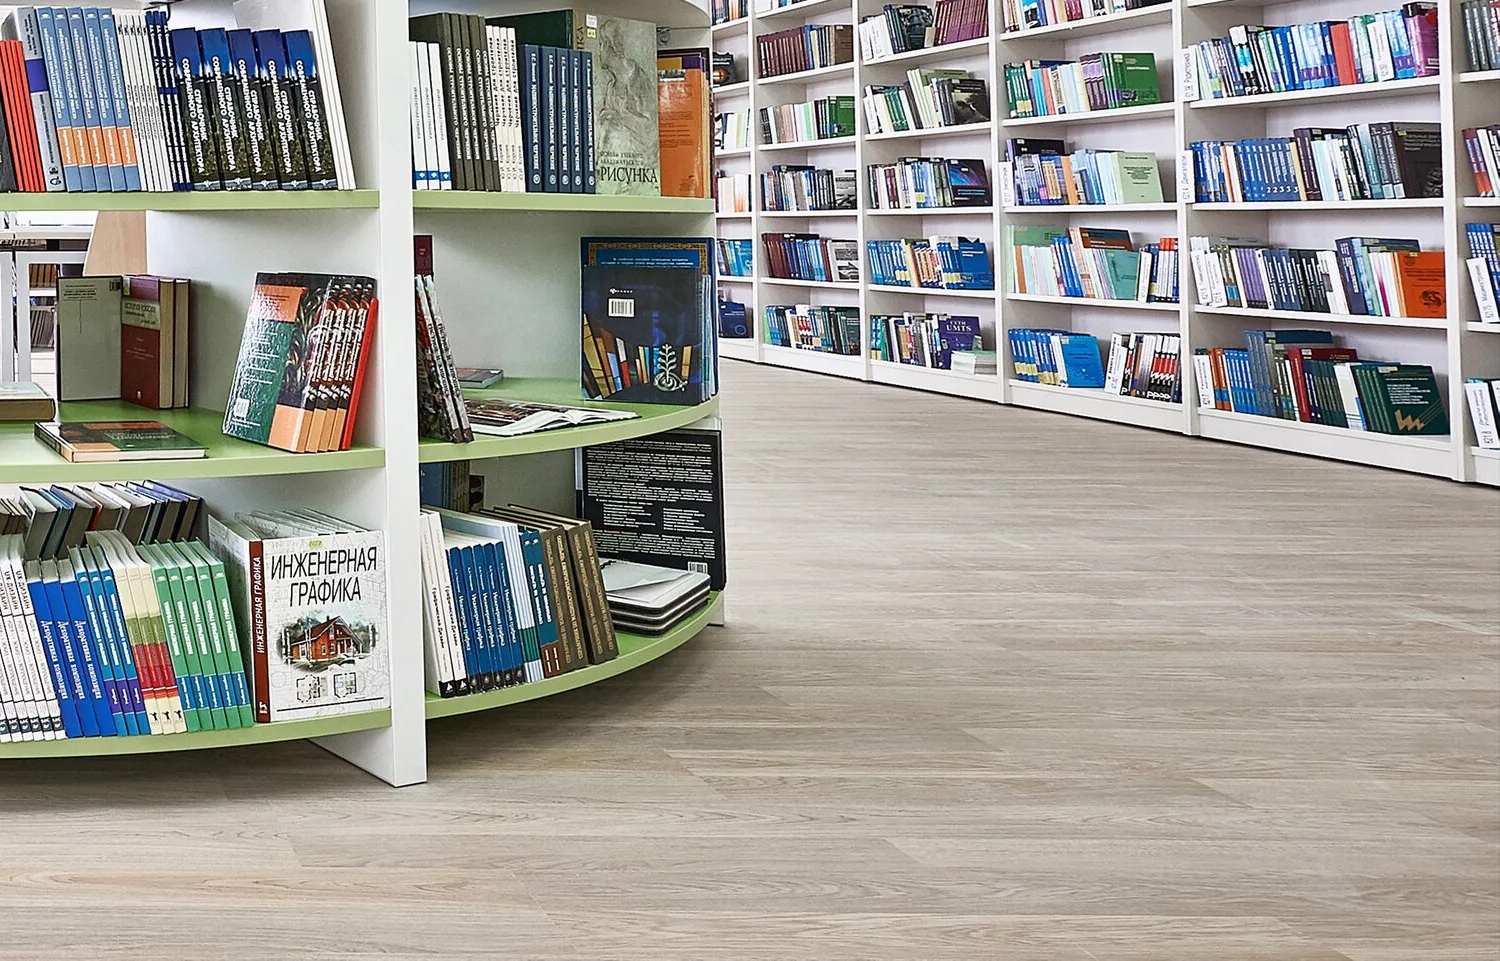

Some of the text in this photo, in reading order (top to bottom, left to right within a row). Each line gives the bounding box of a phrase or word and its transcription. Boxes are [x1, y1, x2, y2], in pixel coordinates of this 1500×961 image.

[181, 57, 205, 172] СОВРЕМЕННОГО АРХИТЕКТОРА
[194, 89, 207, 140] СПРАВОЧНИК
[212, 56, 235, 170] СОВРЕМЕННОГО АРХИТЕКТОРА
[492, 94, 500, 126] Черчение
[600, 166, 658, 184] РИСУНКА
[270, 546, 378, 580] ИНЖЕНЕРНАЯ
[253, 556, 264, 653] ИНЖЕНЕРНАЯ ГРАФИКА
[289, 576, 362, 608] ГРАФИКА
[39, 619, 68, 700] Декоративная композиция
